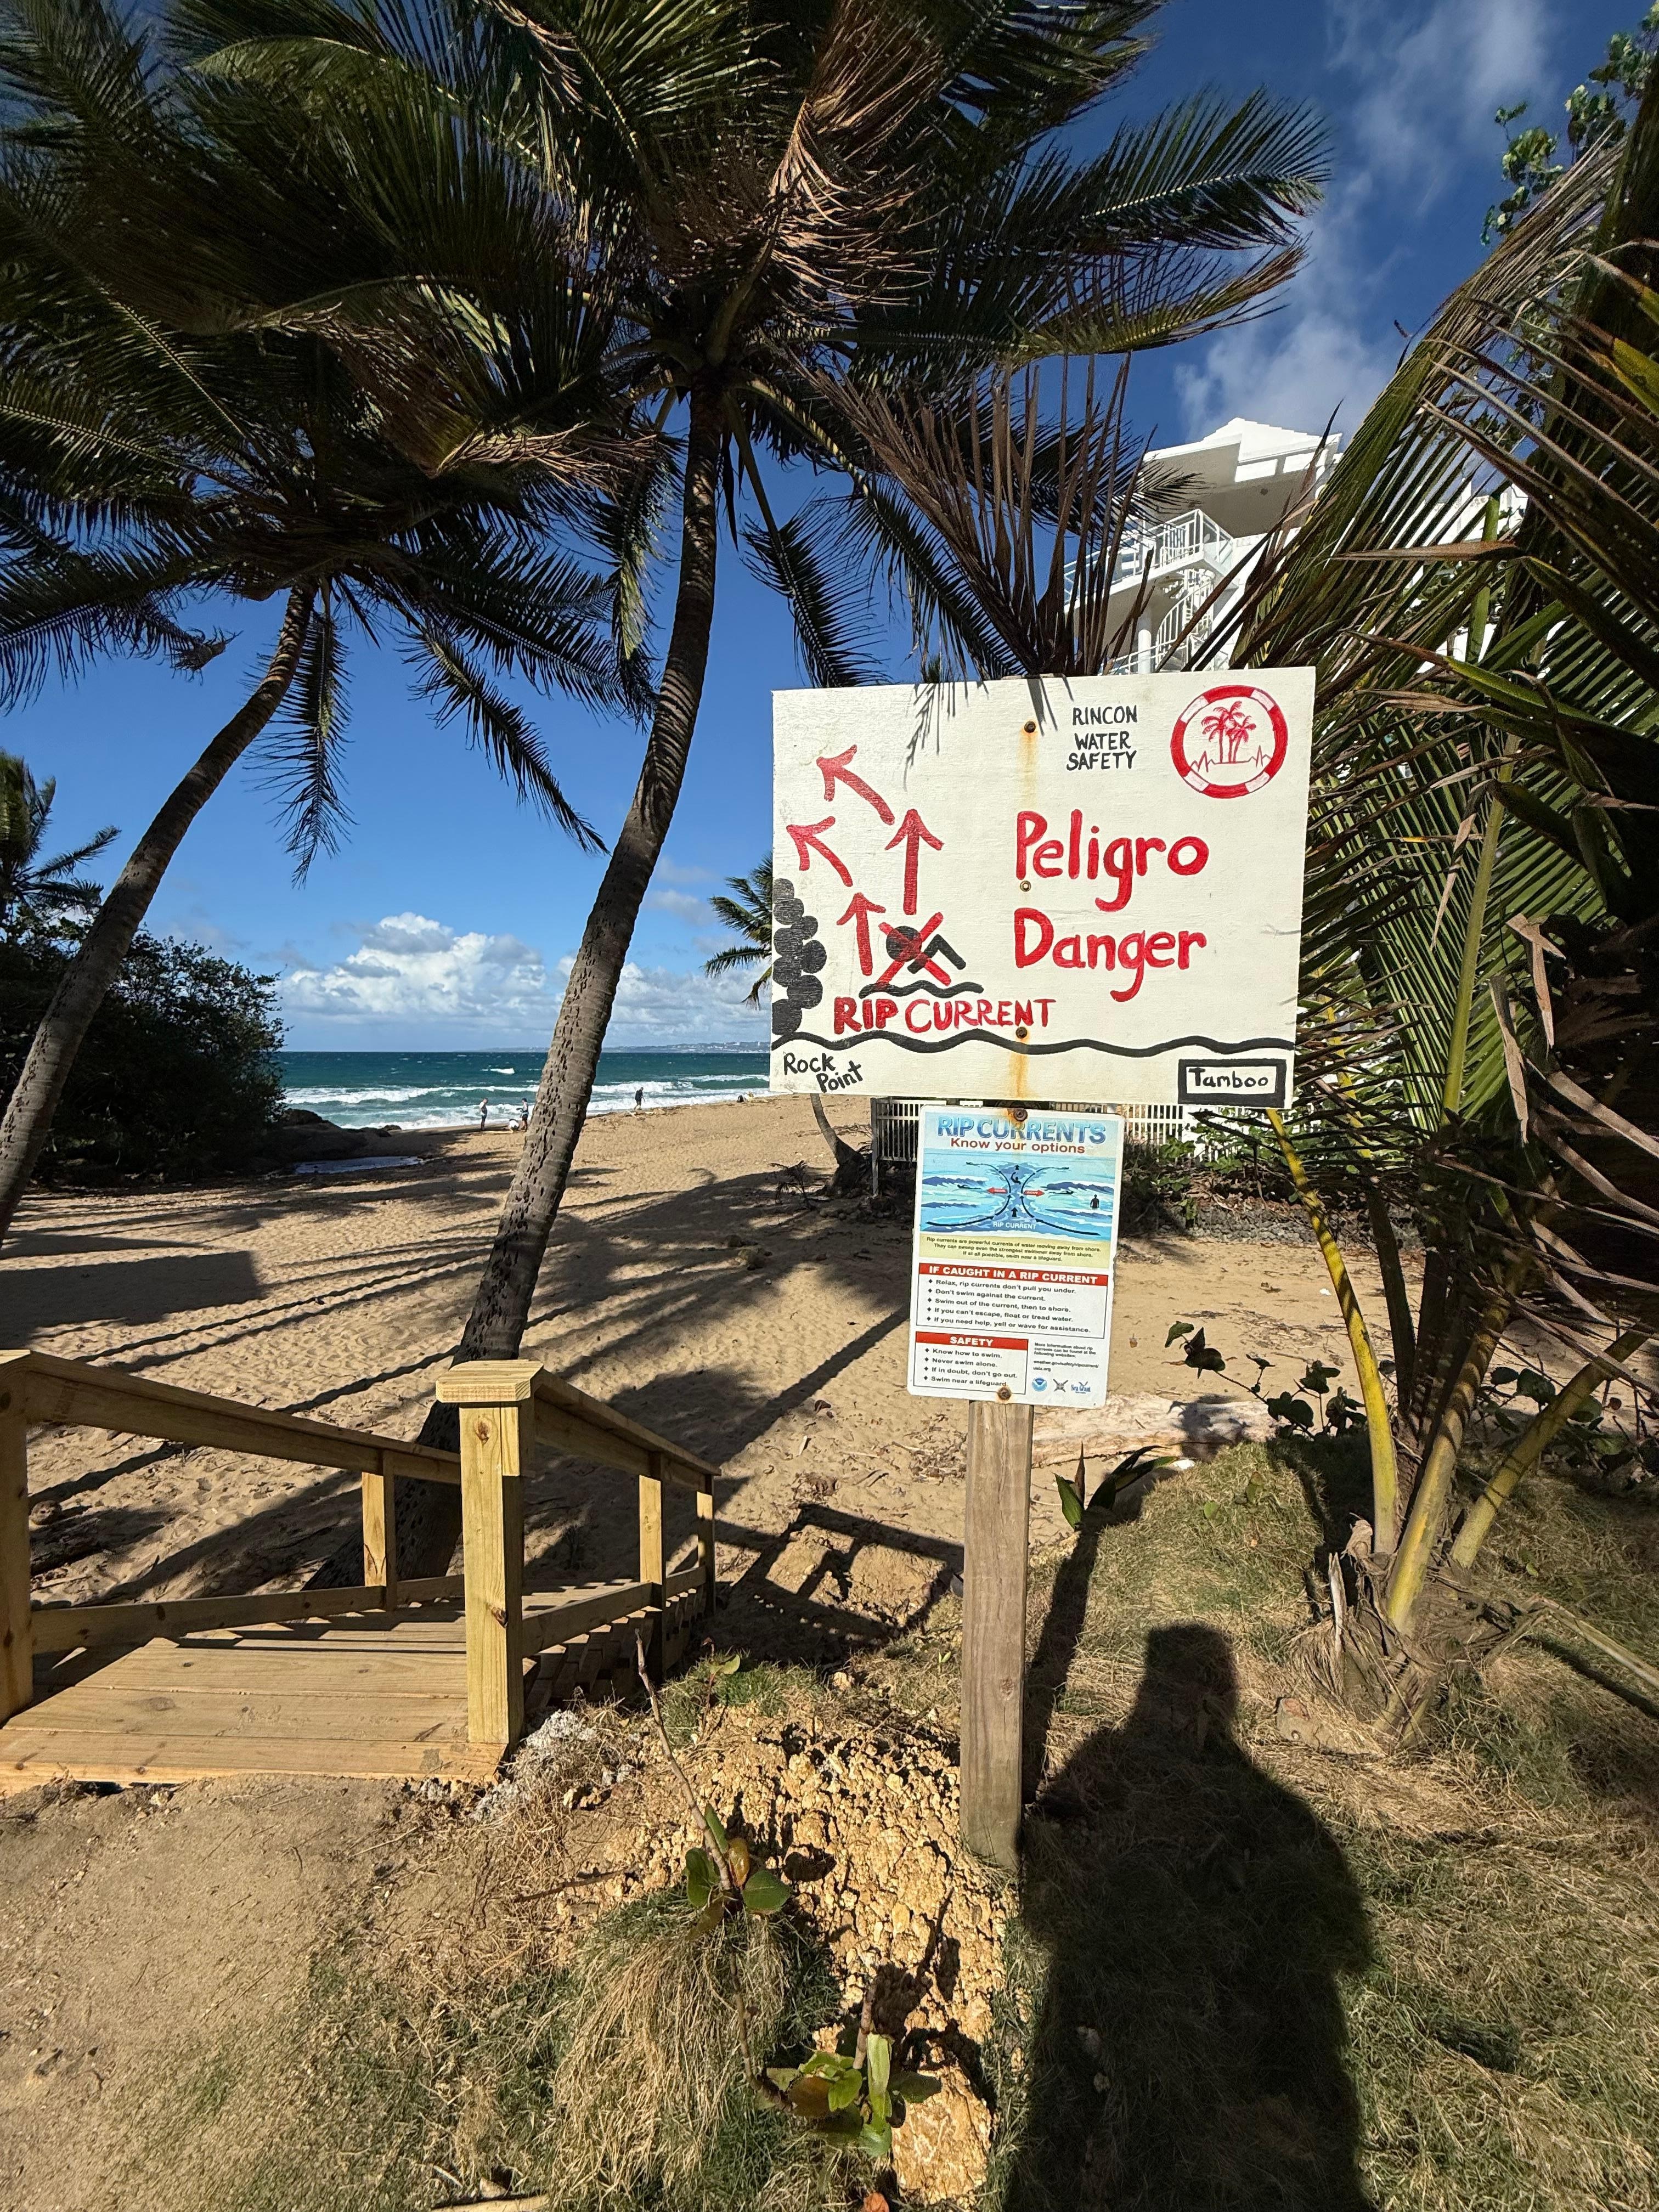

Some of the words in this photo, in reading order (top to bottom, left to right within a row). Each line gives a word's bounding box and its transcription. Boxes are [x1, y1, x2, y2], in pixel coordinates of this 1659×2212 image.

[1073, 705, 1137, 725] RINCON
[1074, 731, 1131, 750] WATER
[1066, 750, 1137, 771] SAFETY
[1017, 809, 1209, 912] Peligro
[1014, 908, 1206, 1001] Danger
[834, 996, 899, 1034] RIP
[905, 998, 1056, 1033] CURRENT
[783, 1052, 836, 1075] Rock
[816, 1060, 863, 1093] Point
[1188, 1067, 1268, 1088] Tamboo
[938, 1115, 974, 1136] RIP
[978, 1119, 1105, 1144] CURRENTS
[951, 1138, 990, 1148] Know
[996, 1142, 1026, 1151] your
[1031, 1143, 1085, 1153] options
[943, 1267, 990, 1277] CAUGHT
[1020, 1272, 1039, 1280] RIP
[1042, 1273, 1098, 1284] CURRENT
[950, 1336, 994, 1346] SAFETY
